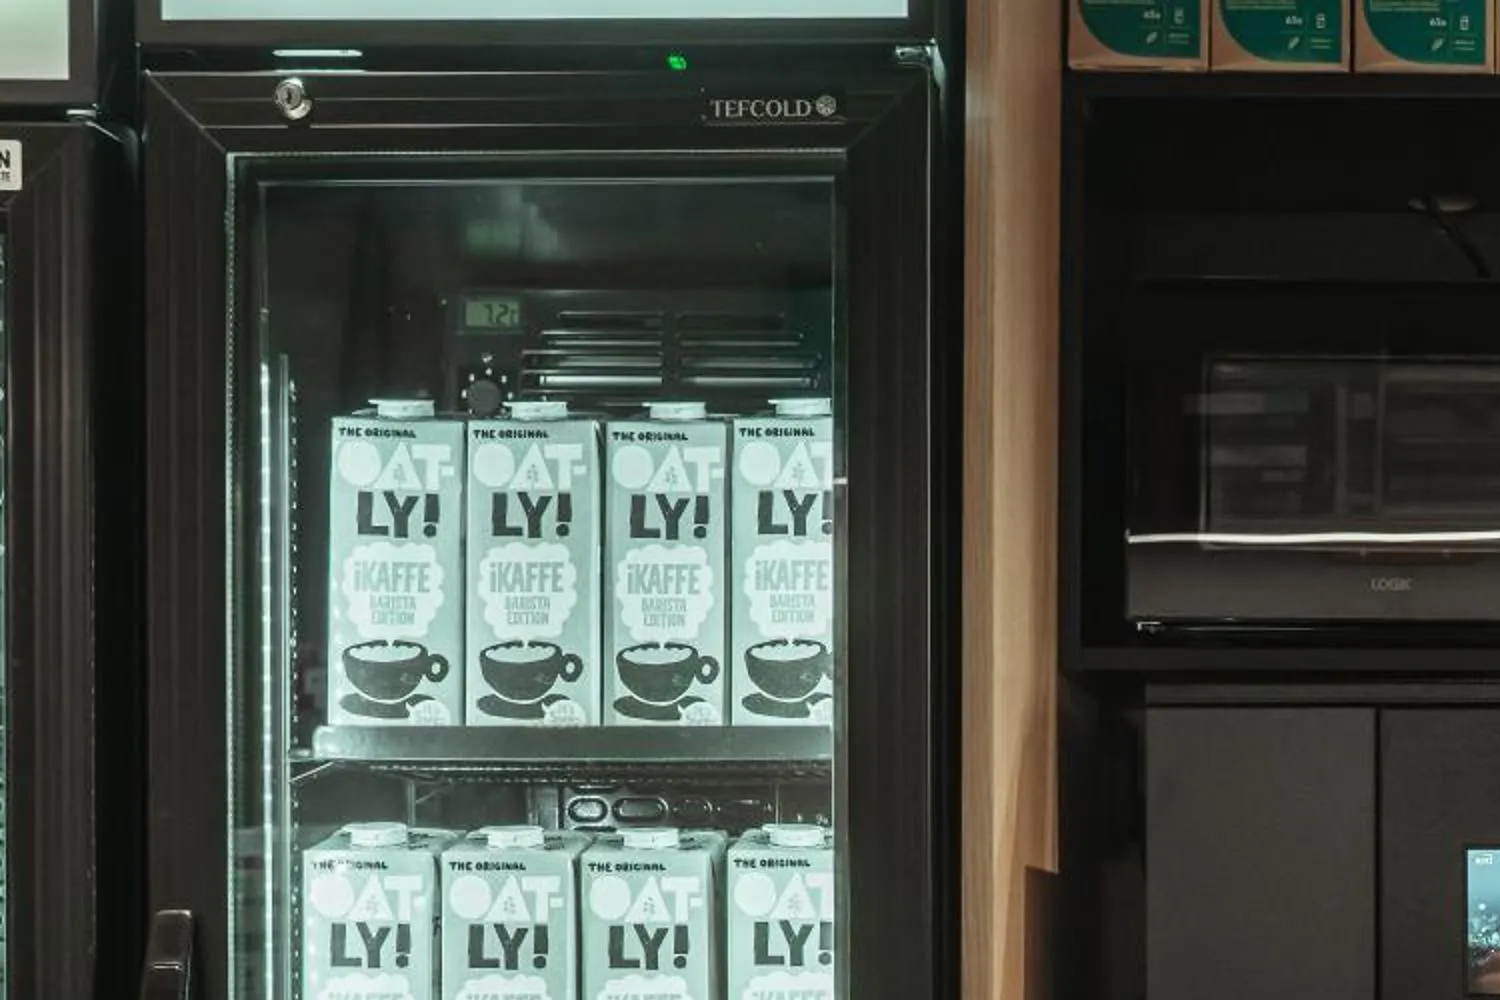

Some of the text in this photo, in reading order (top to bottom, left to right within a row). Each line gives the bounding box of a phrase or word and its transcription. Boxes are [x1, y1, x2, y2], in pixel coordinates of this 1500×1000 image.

[711, 99, 812, 117] TEFCOLD
[339, 428, 417, 438] THE ORIGINAL
[474, 429, 549, 439] THE ORIGINAL
[612, 431, 688, 441] THE ORIGINAL
[740, 428, 816, 437] THE ORIGINAL
[357, 491, 439, 538] LY!
[492, 491, 572, 538] LY!
[630, 494, 709, 540] LY!
[758, 490, 832, 536] LY!
[354, 561, 431, 593] iKAFFE
[489, 561, 565, 593] iKAFFE
[627, 564, 701, 595] iKAFFE
[755, 560, 830, 591] iKAFFE
[449, 861, 527, 871] THE ORIGINAL
[588, 863, 667, 872] THE ORIGINAL
[733, 859, 811, 868] THE ORIGINAL
[330, 922, 411, 968] LY!
[467, 923, 548, 970] LY!
[608, 923, 688, 970] LY!
[754, 920, 832, 966] LY!
